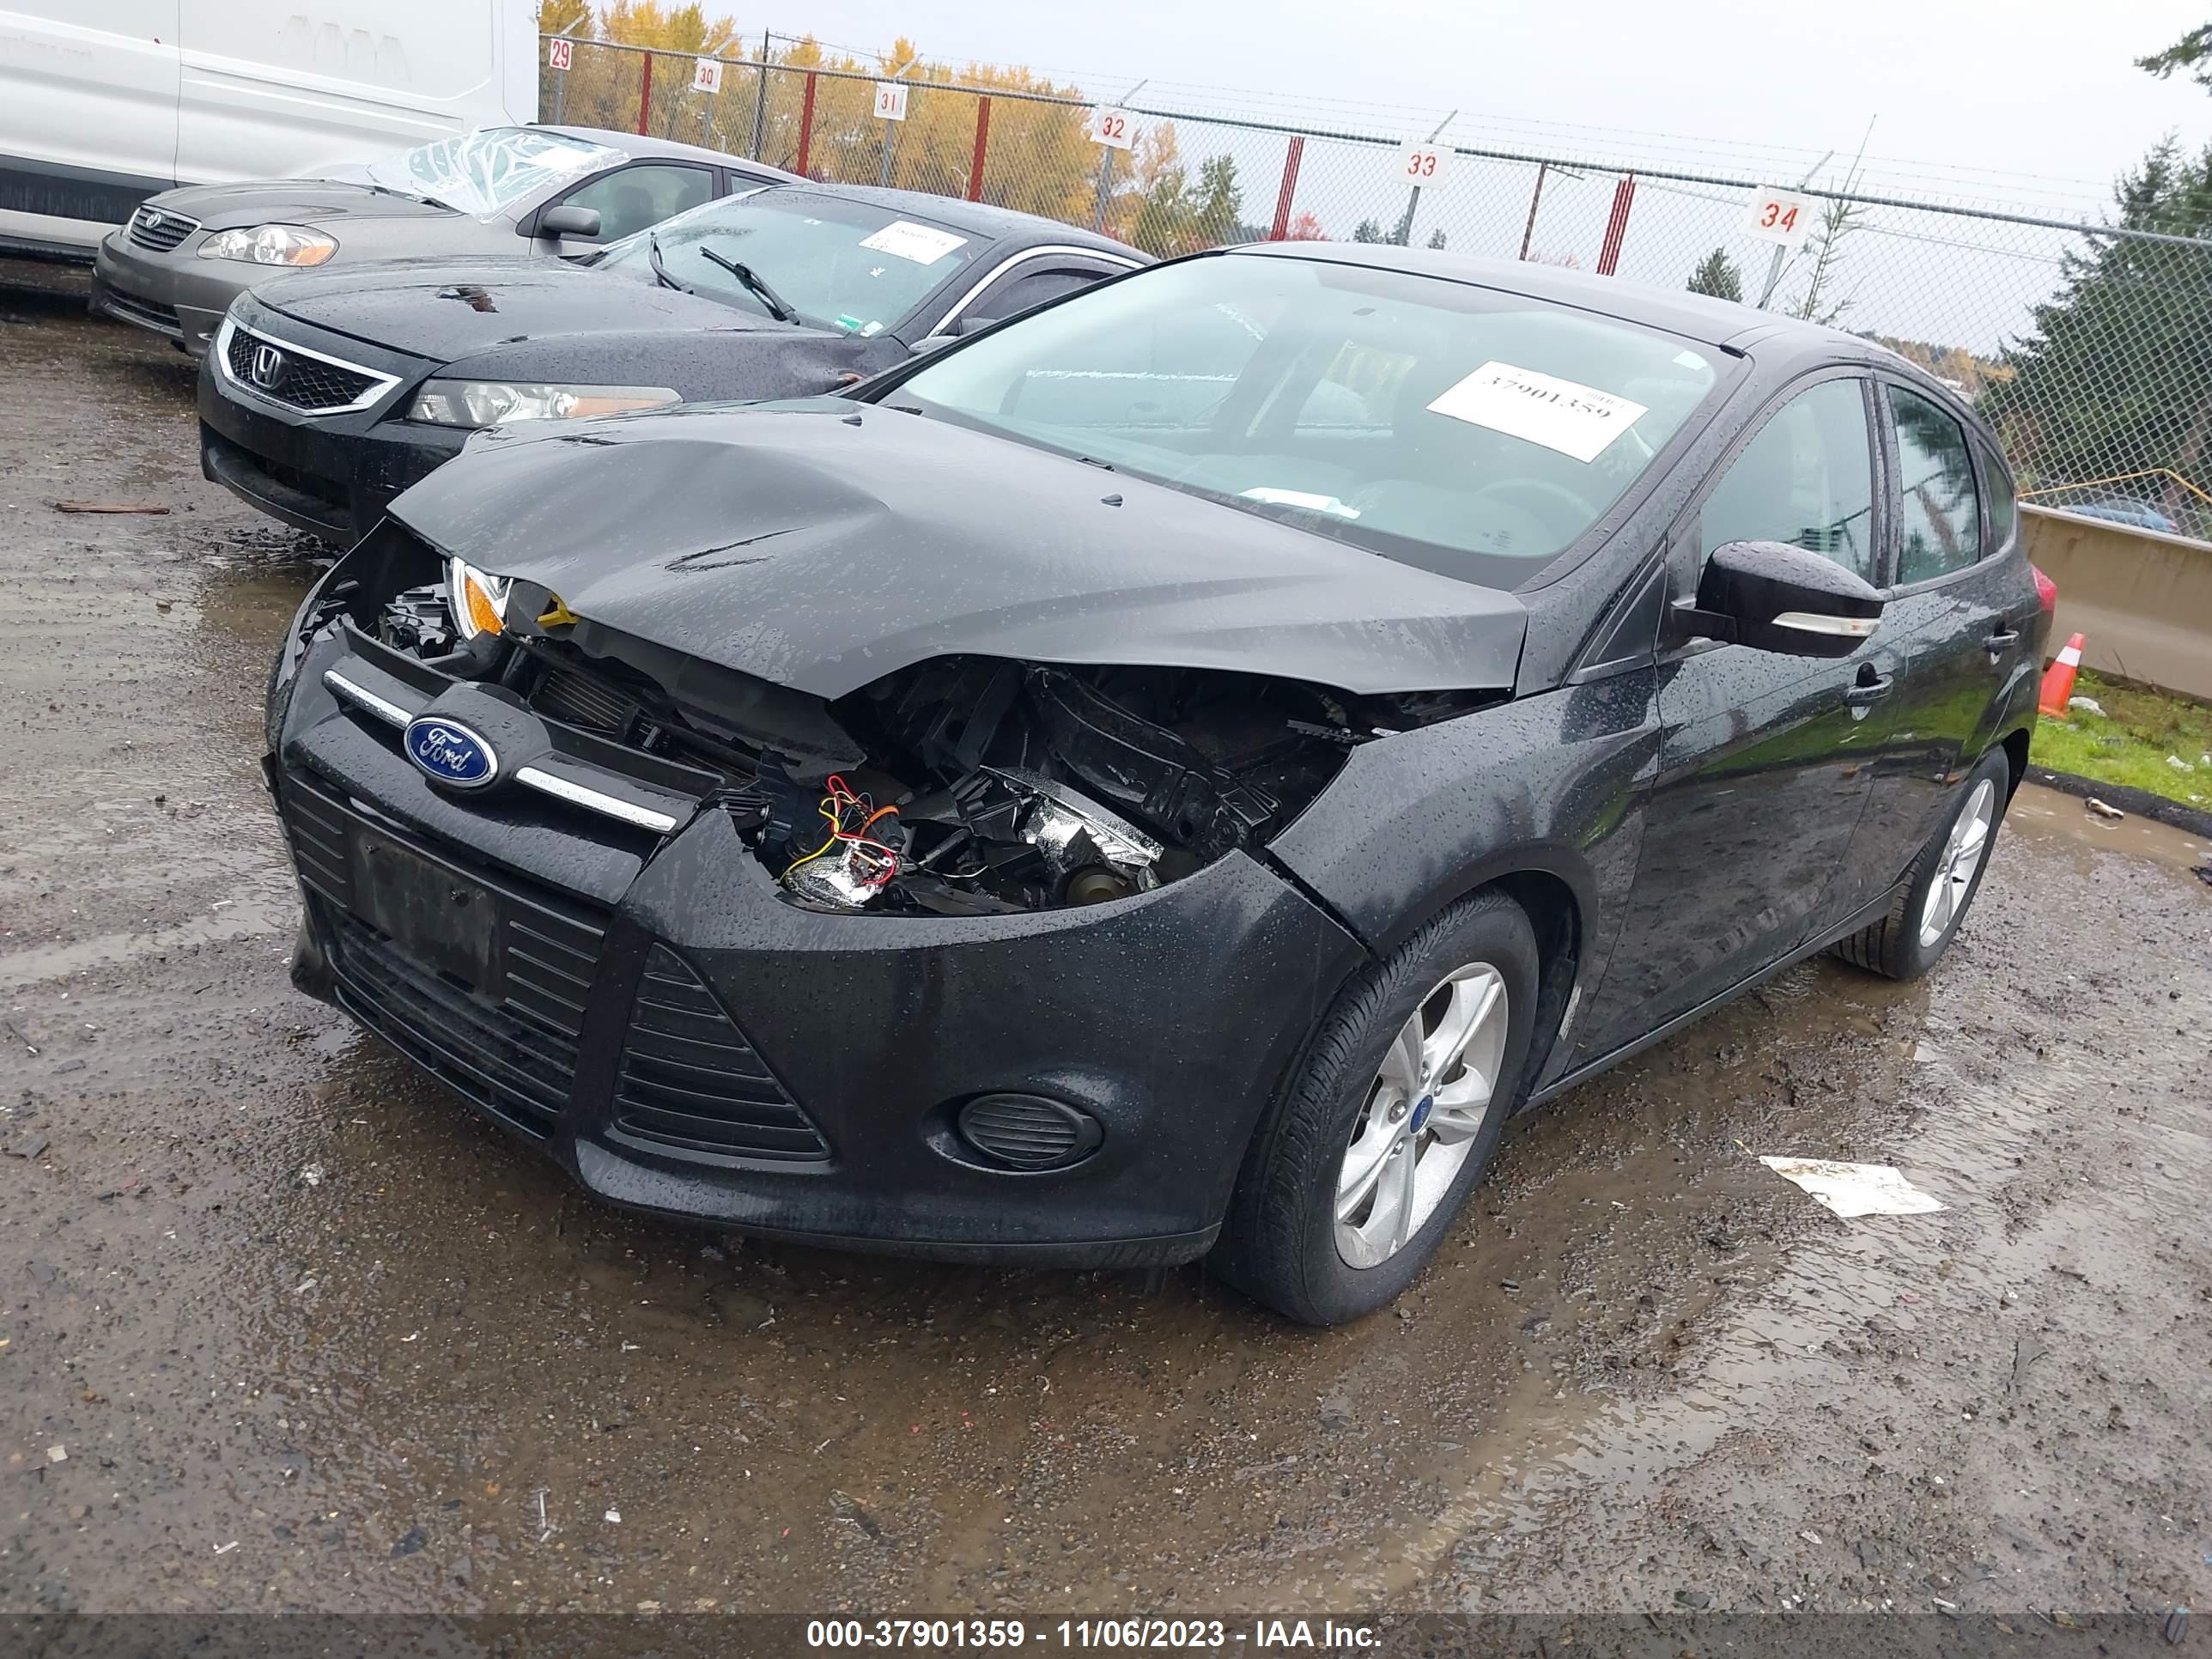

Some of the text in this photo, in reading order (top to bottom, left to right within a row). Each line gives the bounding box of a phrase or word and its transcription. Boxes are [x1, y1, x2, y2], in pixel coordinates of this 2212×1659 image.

[552, 40, 569, 68] 29
[700, 68, 714, 84] 30
[881, 93, 896, 112] 31
[1103, 116, 1125, 138] 32
[1407, 154, 1437, 177] 33
[1760, 203, 1799, 232] 34
[1485, 376, 1612, 418] 37901359
[419, 727, 472, 772] Ford
